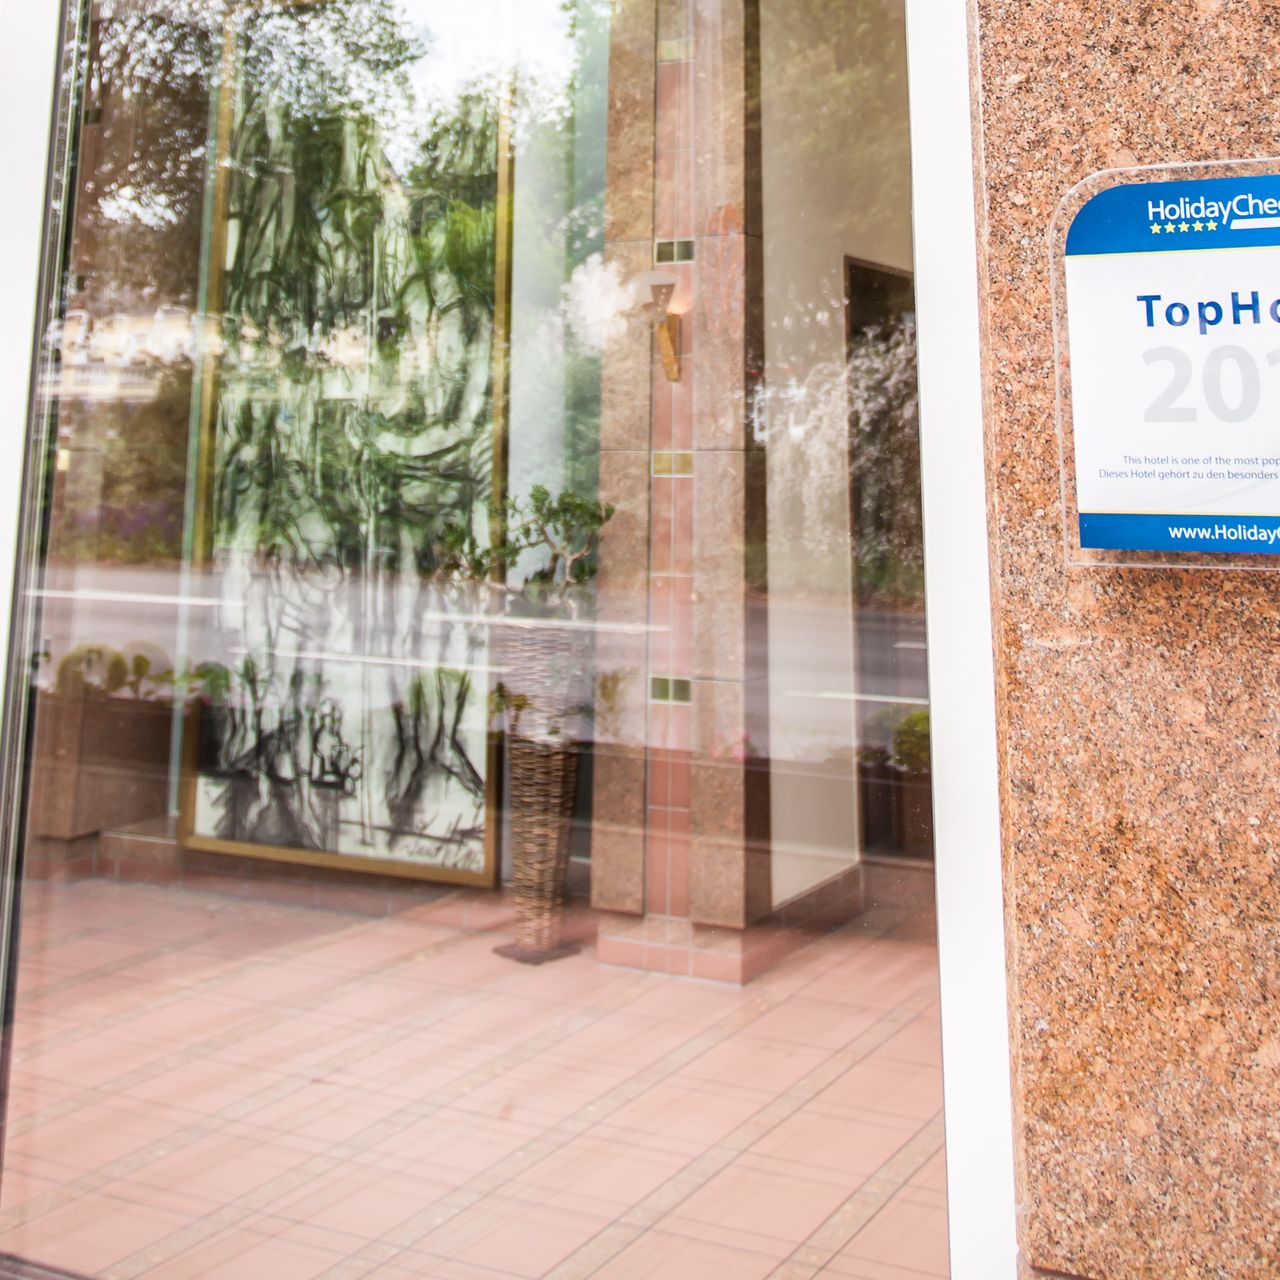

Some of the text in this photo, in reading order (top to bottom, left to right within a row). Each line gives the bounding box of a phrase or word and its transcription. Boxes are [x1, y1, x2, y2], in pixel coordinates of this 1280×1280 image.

[1123, 455, 1142, 465] This
[1144, 455, 1169, 465] hotel
[1171, 455, 1179, 465] is
[1181, 457, 1200, 465] one
[1202, 455, 1213, 465] of
[1215, 455, 1231, 465] the
[1234, 456, 1259, 466] most
[1098, 469, 1129, 479] Dieses
[1131, 469, 1156, 479] Hotel
[1158, 469, 1190, 481] gehört
[1206, 470, 1225, 479] den
[1227, 470, 1279, 480] besonders
